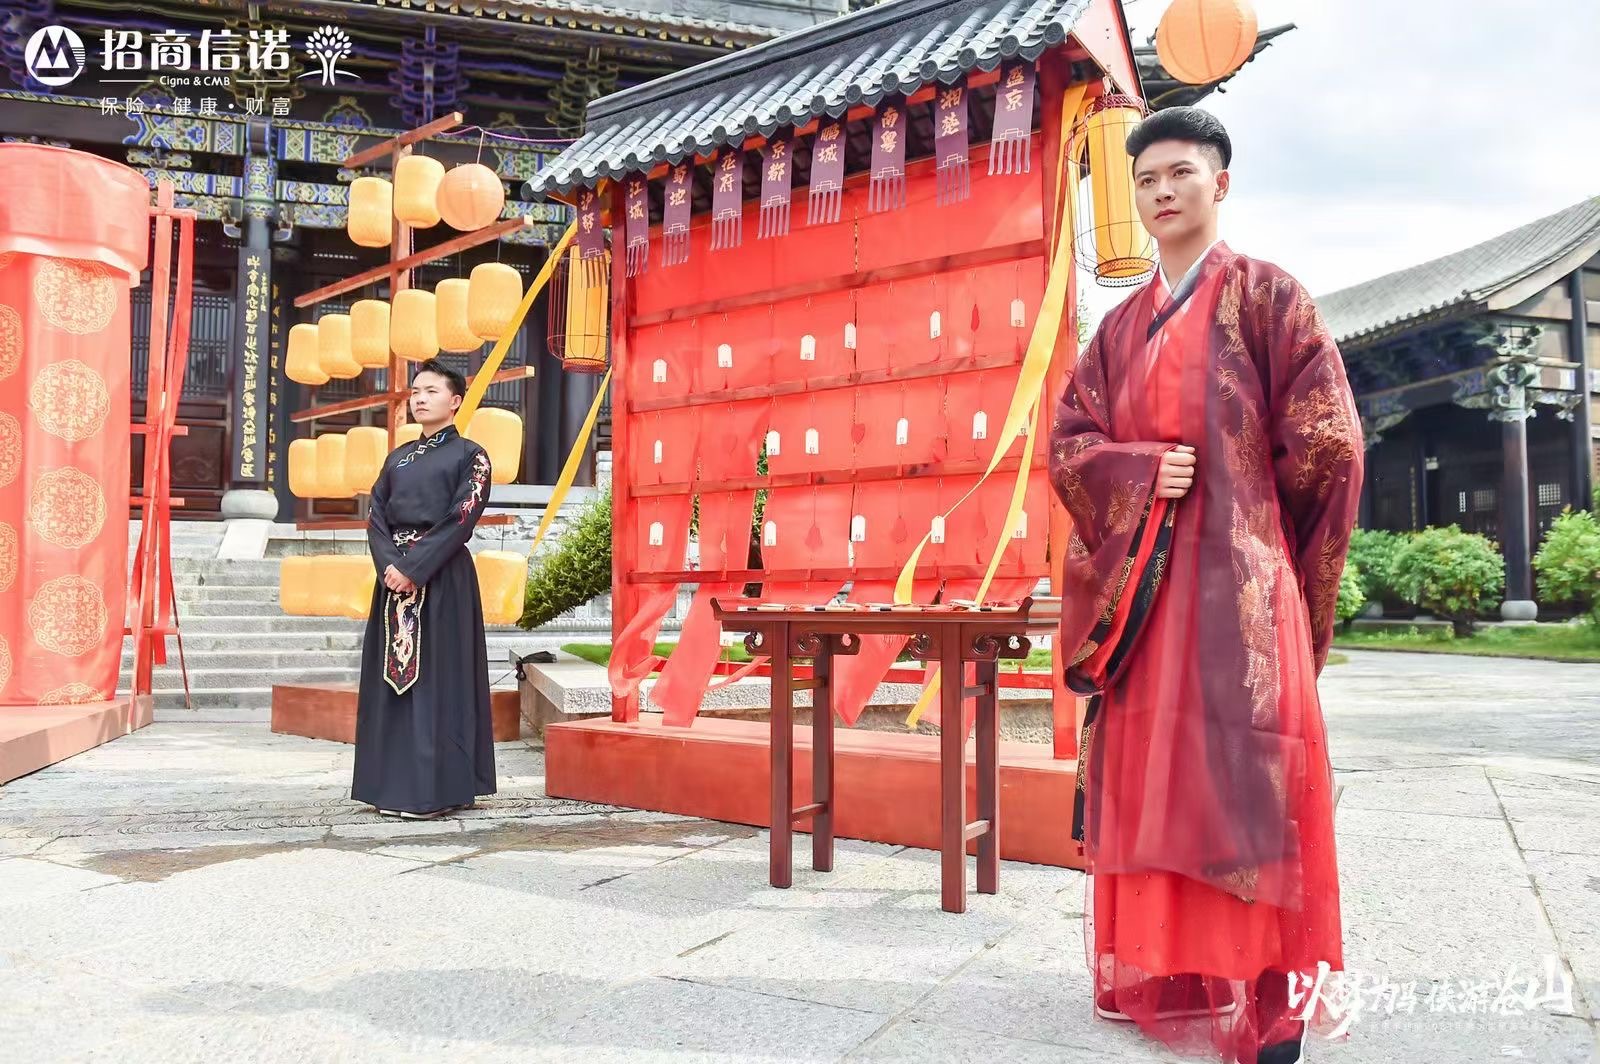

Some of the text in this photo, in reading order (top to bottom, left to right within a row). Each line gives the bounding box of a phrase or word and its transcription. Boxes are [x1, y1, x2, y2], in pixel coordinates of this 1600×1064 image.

[1005, 65, 1025, 111] 盛京
[941, 87, 963, 137] 湘楚
[767, 140, 786, 182] 京都
[818, 123, 840, 163] 鹏城
[629, 181, 644, 219] 江城
